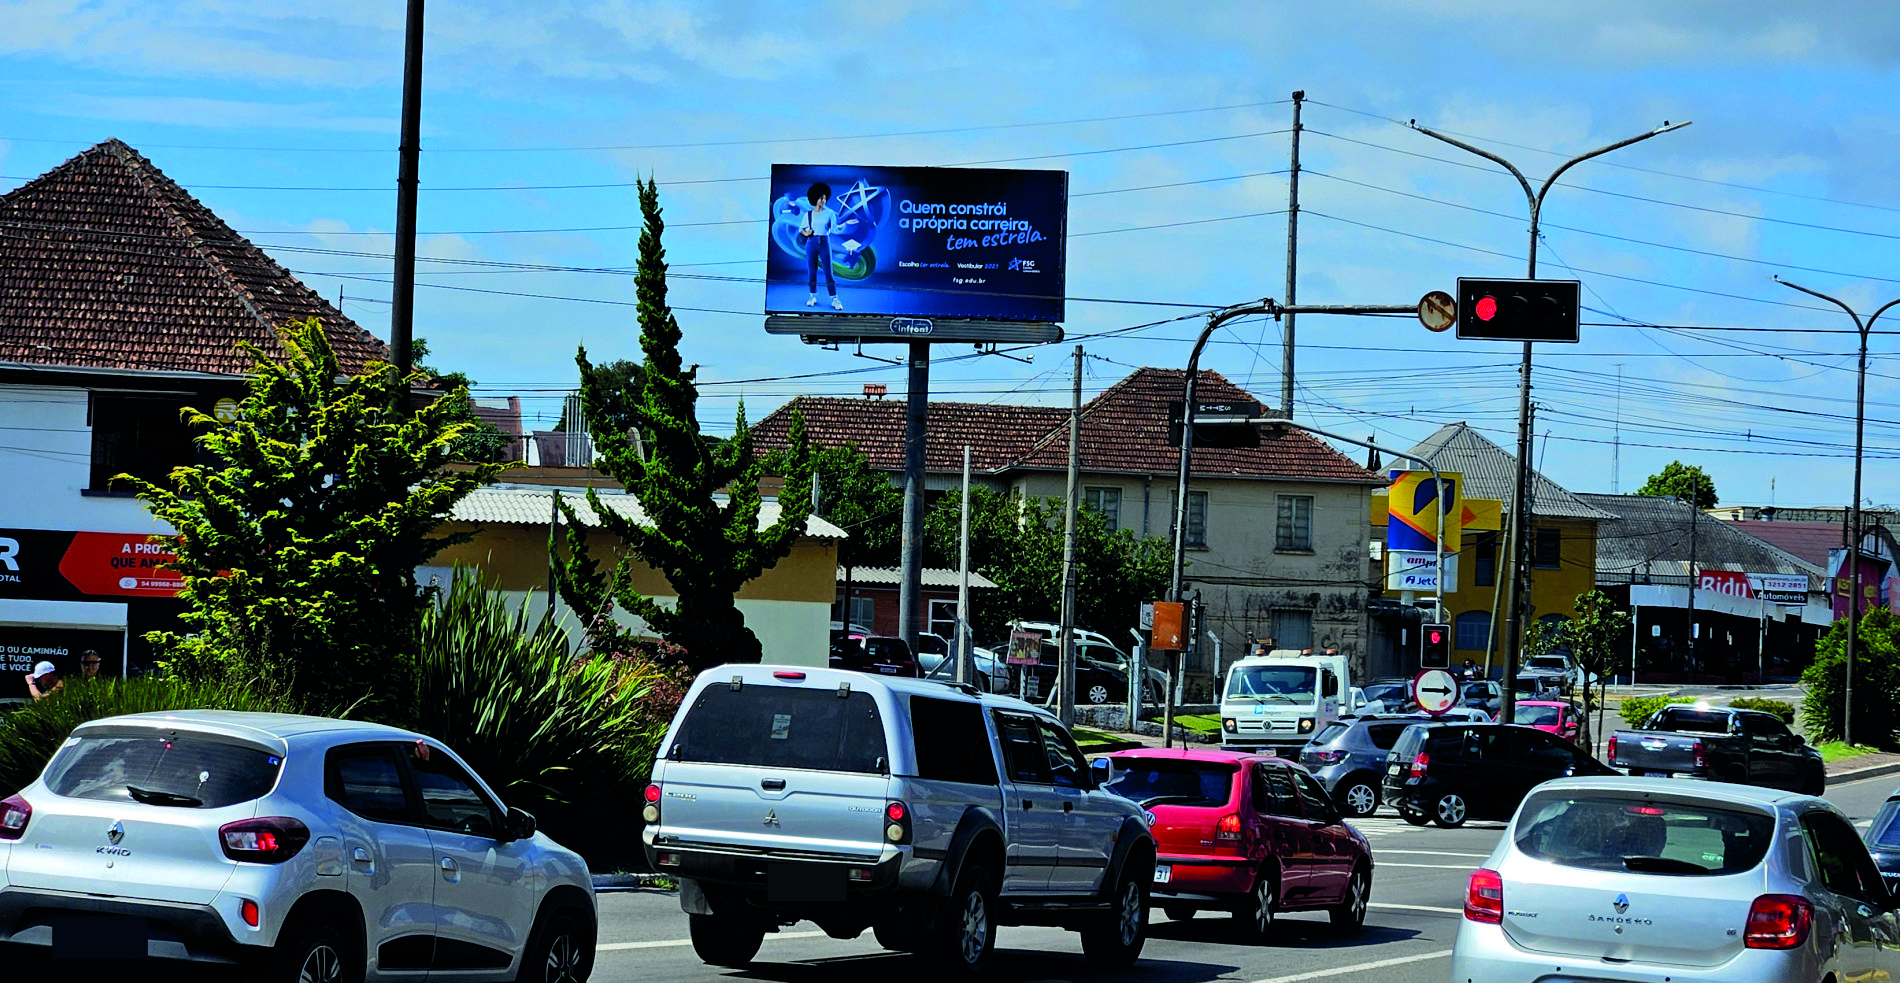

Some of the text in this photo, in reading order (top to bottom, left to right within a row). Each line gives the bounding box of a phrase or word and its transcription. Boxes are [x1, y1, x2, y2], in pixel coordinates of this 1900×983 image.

[899, 200, 1007, 216] Quem constrói
[898, 217, 910, 229] a
[912, 215, 967, 234] própria
[946, 225, 1047, 251] tem estrela.
[952, 276, 987, 285] fsg.edu.br
[898, 319, 930, 333] infront
[121, 543, 132, 554] A
[110, 557, 137, 569] QUE
[1701, 576, 1748, 598] Bidu
[1757, 591, 1806, 601] Automóveis
[7, 646, 20, 654] OU
[21, 646, 69, 656] CAMINHÃO
[8, 654, 34, 663] TUDO.
[9, 663, 32, 672] VOCÊ
[96, 846, 132, 857] KWID
[1588, 914, 1653, 926] SANDERO
